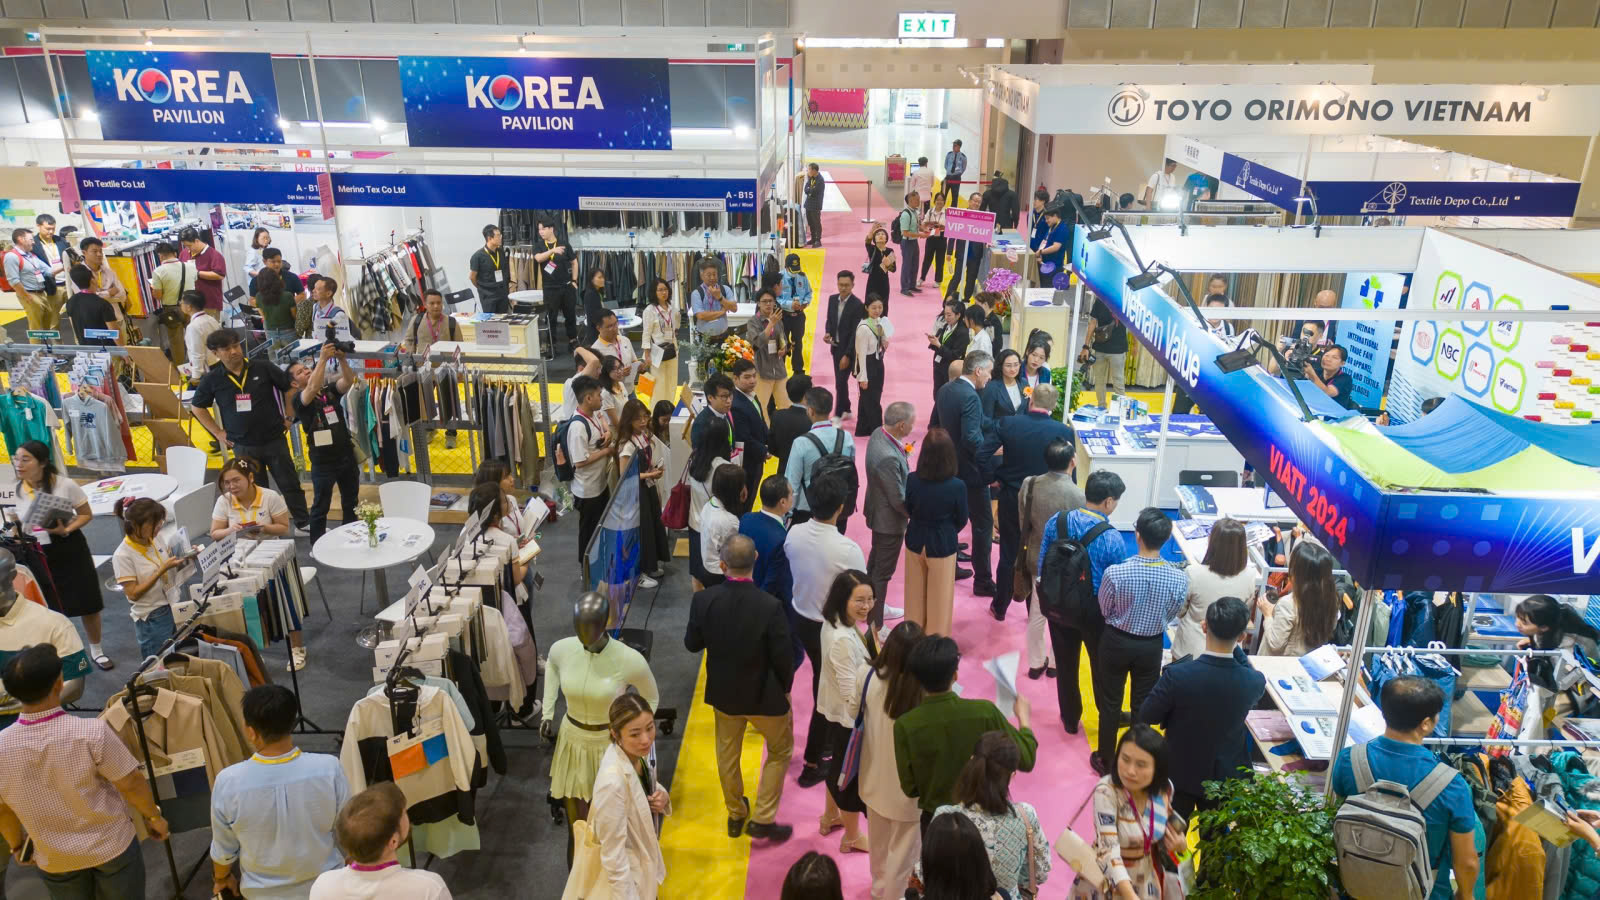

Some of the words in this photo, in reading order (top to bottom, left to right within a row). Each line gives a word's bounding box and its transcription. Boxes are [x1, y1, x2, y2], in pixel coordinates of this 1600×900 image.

[903, 19, 951, 33] EXIT
[113, 67, 253, 105] KOREA
[464, 74, 605, 111] KOREA
[152, 108, 226, 125] PAVILION
[1153, 98, 1233, 122] TOYO
[1243, 98, 1394, 122] ORIMONO
[1404, 99, 1533, 123] VIETNAM
[501, 115, 575, 132] PAVILION
[83, 179, 94, 187] Dh
[94, 179, 121, 188] Textile
[121, 180, 132, 188] Co
[132, 180, 146, 189] Ltd
[296, 184, 303, 192] A
[308, 184, 319, 192] B1
[338, 185, 365, 194] Merino
[365, 185, 381, 194] Tex
[381, 186, 393, 194] Co
[393, 186, 406, 194] Ltd
[726, 191, 733, 199] A
[738, 191, 754, 199] B15
[1409, 195, 1442, 206] Textile
[1443, 196, 1470, 208] Depo
[1471, 196, 1509, 208] Co.,Ltd
[946, 221, 965, 233] VIP
[967, 224, 991, 236] Tour
[1121, 277, 1164, 352] Vietnam
[1165, 316, 1201, 388] Value
[1356, 321, 1376, 336] VIETNAM
[1347, 332, 1379, 351] INTERNATIONAL
[1350, 344, 1363, 356] TRADE
[1268, 443, 1309, 504] VIATT
[1307, 486, 1349, 548] 2024
[205, 548, 218, 562] LAYER
[206, 557, 218, 569] LAYER
